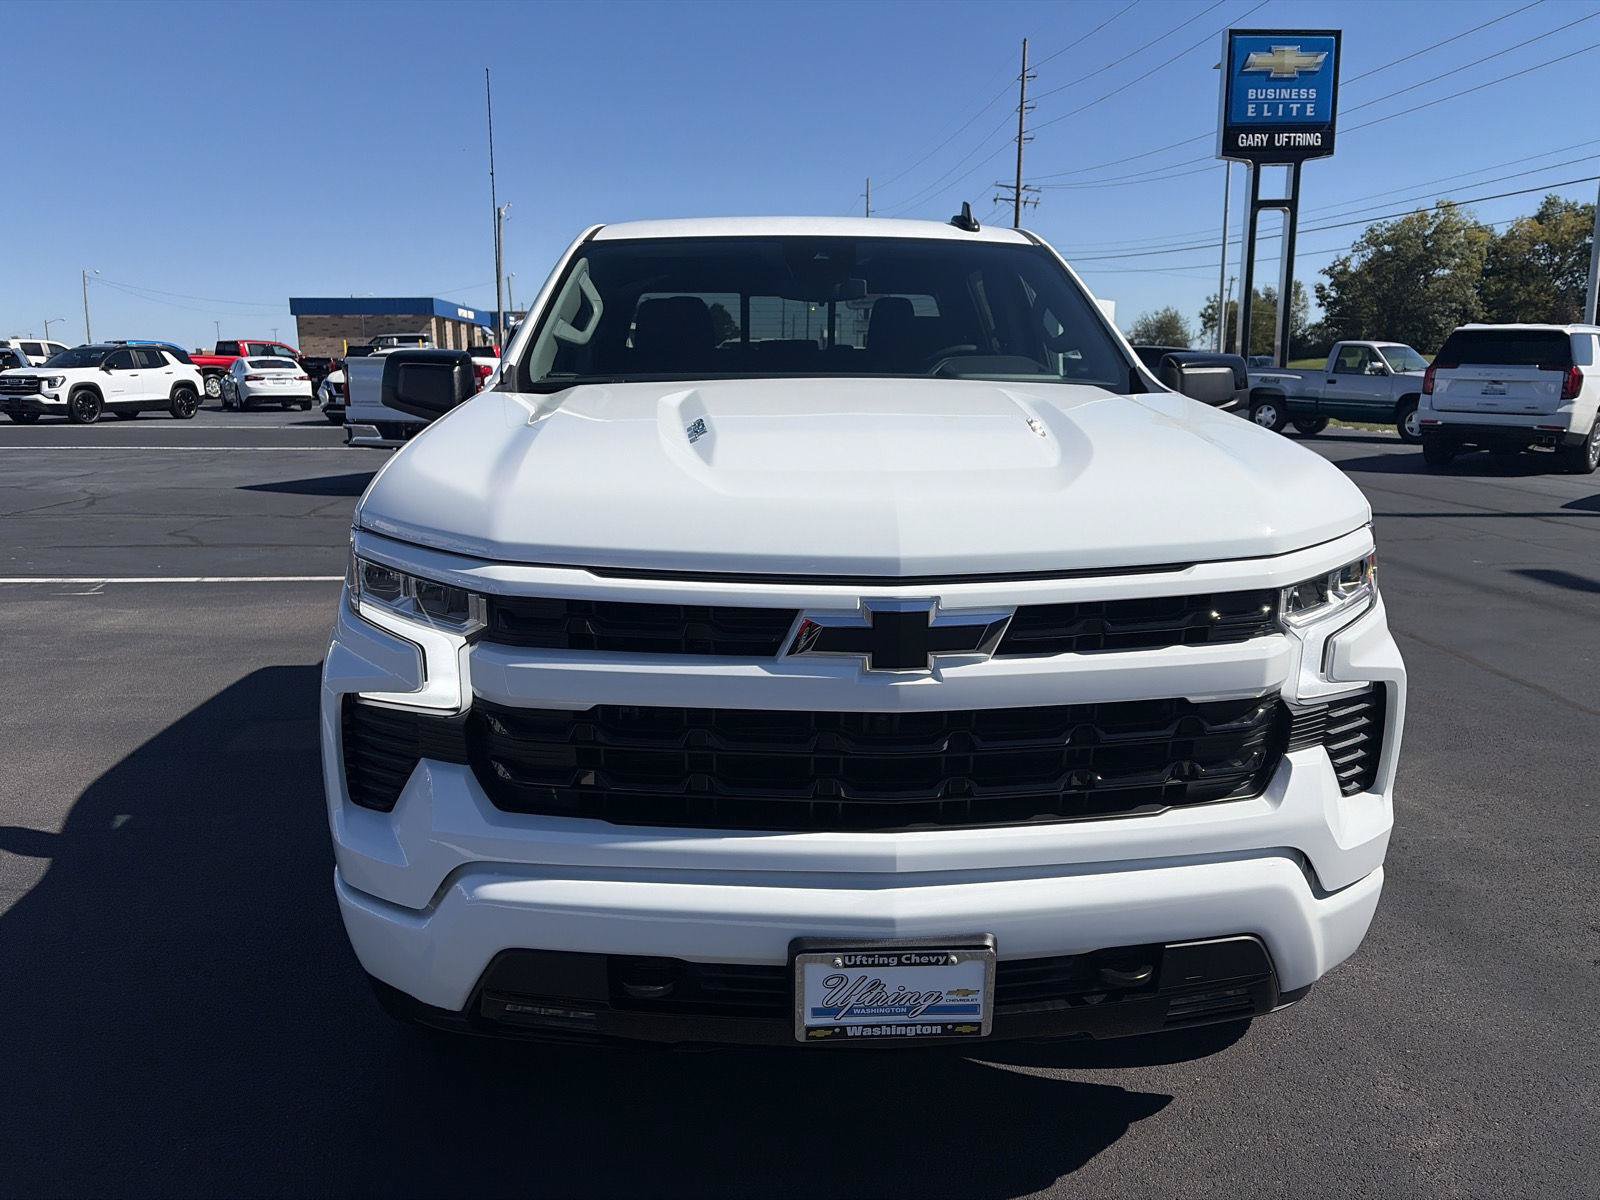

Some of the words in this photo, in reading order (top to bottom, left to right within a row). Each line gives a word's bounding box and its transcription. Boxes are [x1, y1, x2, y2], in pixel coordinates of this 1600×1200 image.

[1247, 88, 1317, 99] BUSINESS
[1247, 103, 1315, 116] ELITE
[1238, 133, 1269, 147] GARY
[1274, 132, 1322, 147] UFTRING
[844, 954, 898, 966] Uftring
[901, 953, 947, 965] Chevy
[822, 973, 944, 1020] Uftring
[853, 1007, 907, 1015] WASHINGTON
[846, 1025, 942, 1037] Washington
